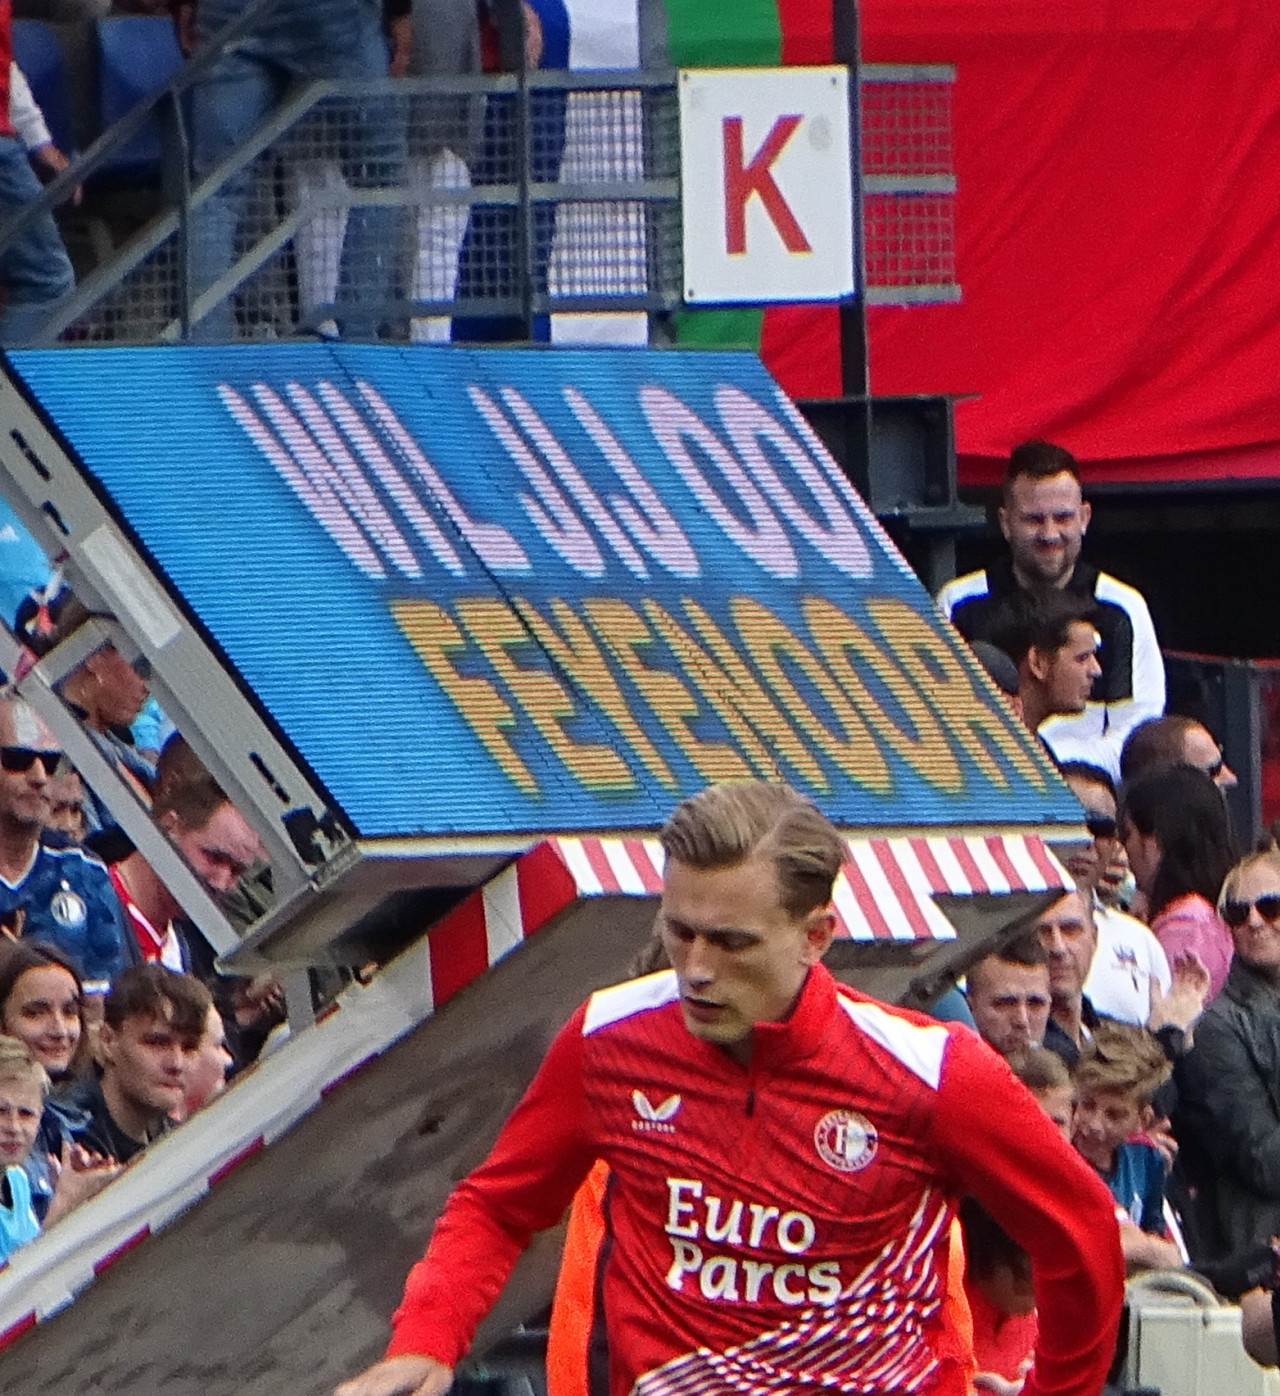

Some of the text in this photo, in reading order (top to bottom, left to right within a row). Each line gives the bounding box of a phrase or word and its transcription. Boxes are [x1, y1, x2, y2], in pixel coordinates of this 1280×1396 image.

[722, 114, 813, 255] K
[217, 381, 917, 581] WIL JIJ OO
[389, 595, 1067, 796] FEYENOOR
[664, 1177, 815, 1254] Euro
[665, 1236, 842, 1308] Parcs
